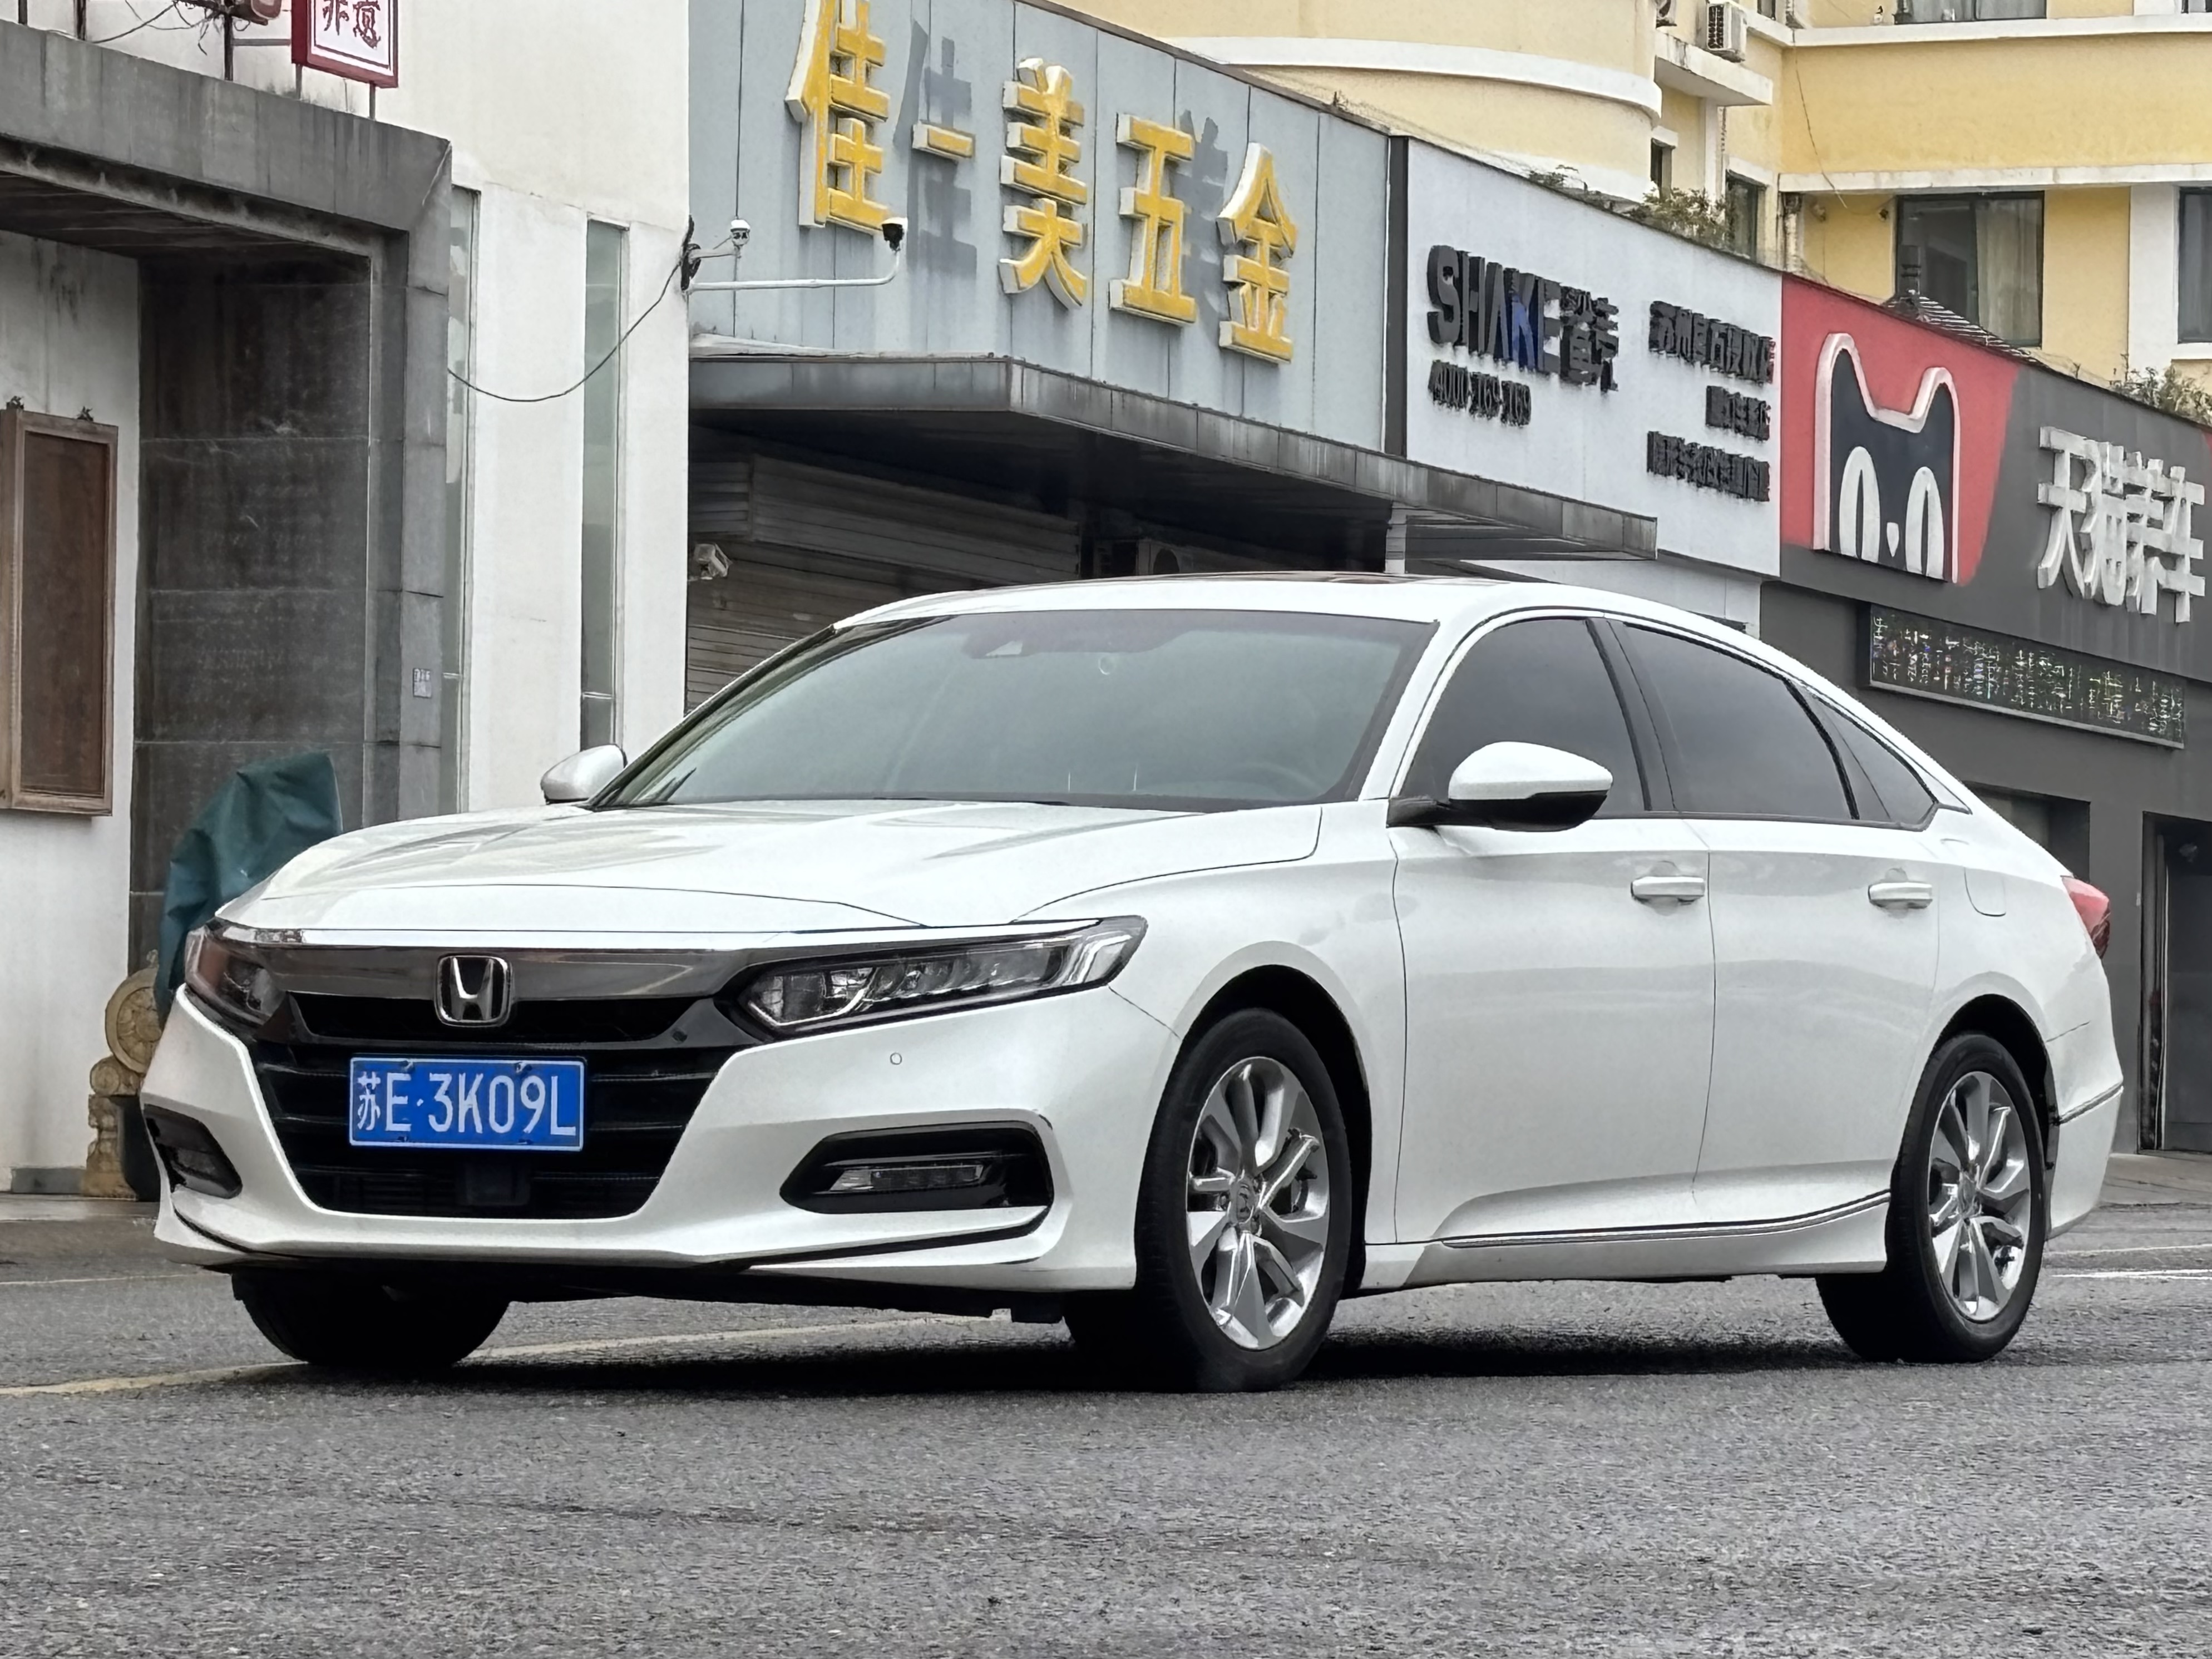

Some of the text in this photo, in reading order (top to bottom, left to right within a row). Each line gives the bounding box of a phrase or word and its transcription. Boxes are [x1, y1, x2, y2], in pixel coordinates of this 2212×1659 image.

[1426, 245, 1561, 375] SHAKE
[2037, 426, 2205, 624] 天猫养车
